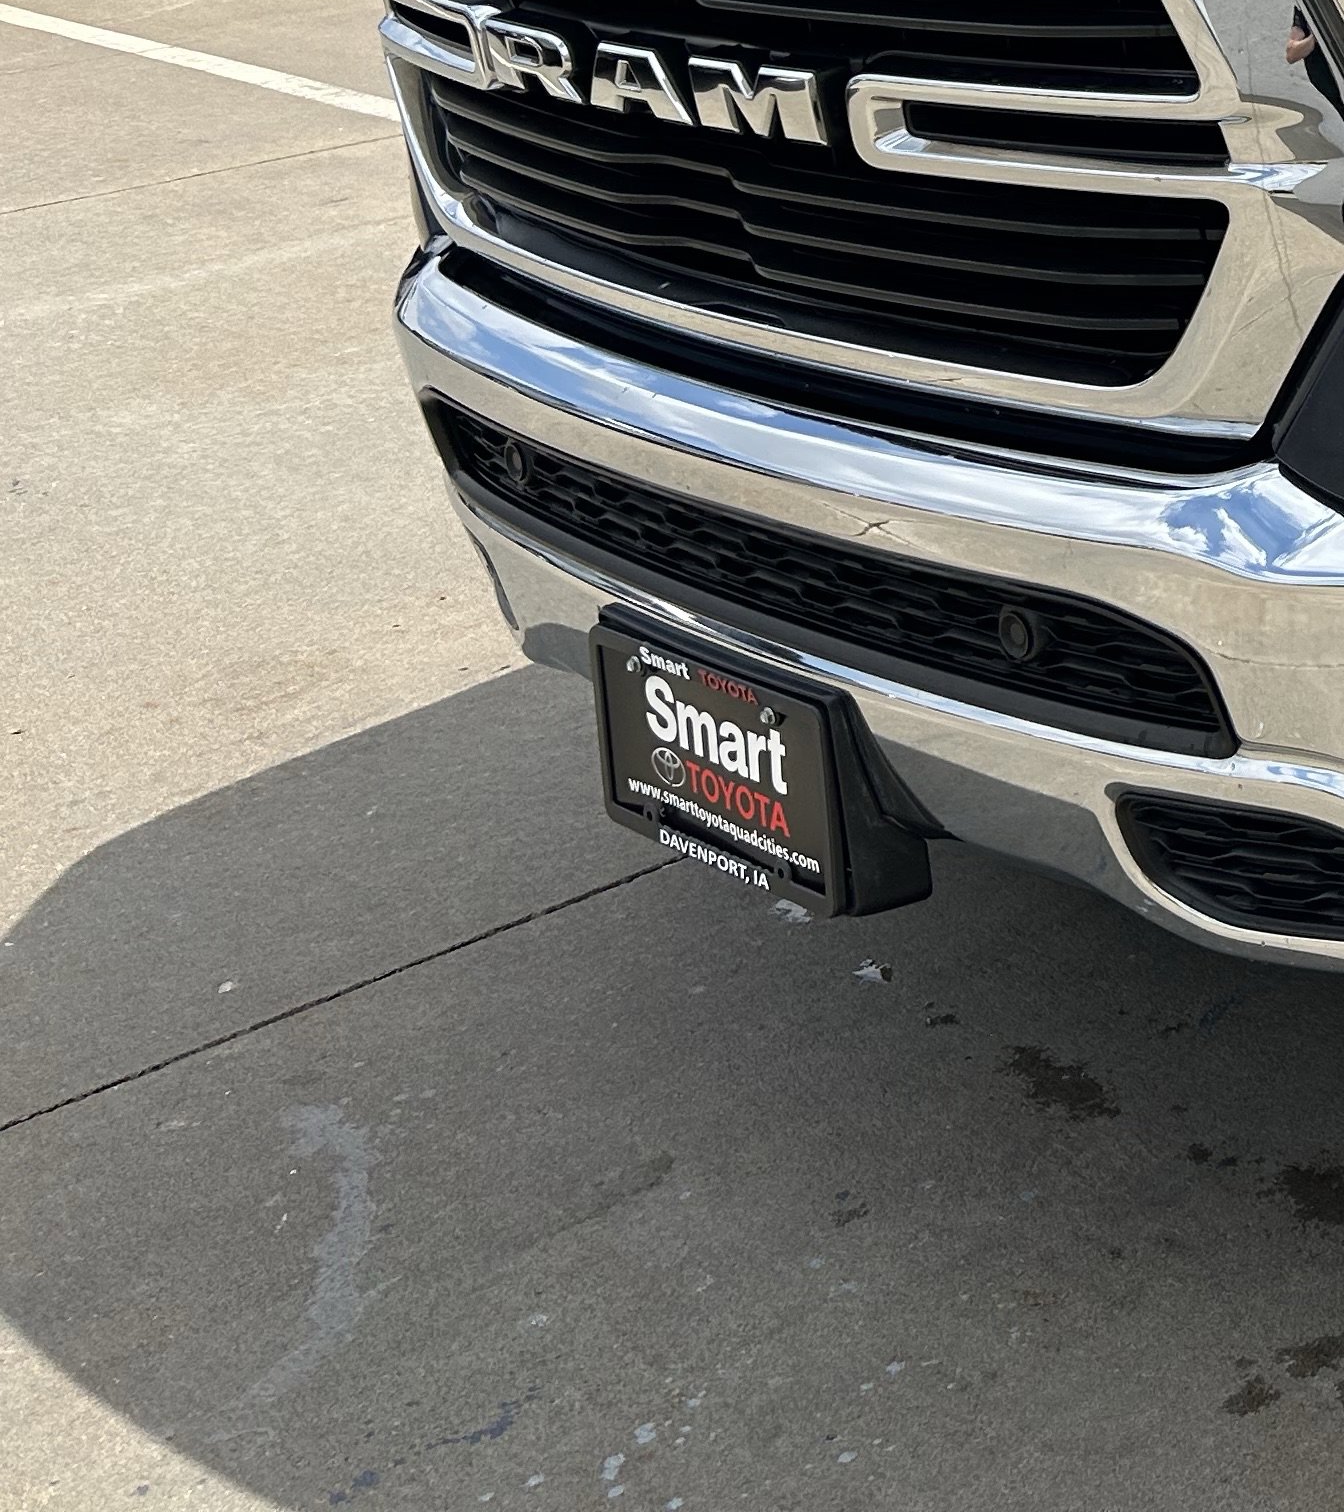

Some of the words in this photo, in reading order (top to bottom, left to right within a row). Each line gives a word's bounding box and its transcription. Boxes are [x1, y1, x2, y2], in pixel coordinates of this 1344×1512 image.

[484, 19, 831, 147] RAM
[639, 646, 691, 680] Smart
[697, 669, 759, 706] TOYOTA
[645, 675, 788, 795] Smart
[628, 778, 820, 874] www.smarttoyotaquadcities.com
[684, 760, 790, 838] TOYOTA
[659, 829, 750, 884] DAVENPORT,
[753, 871, 772, 891] IA
